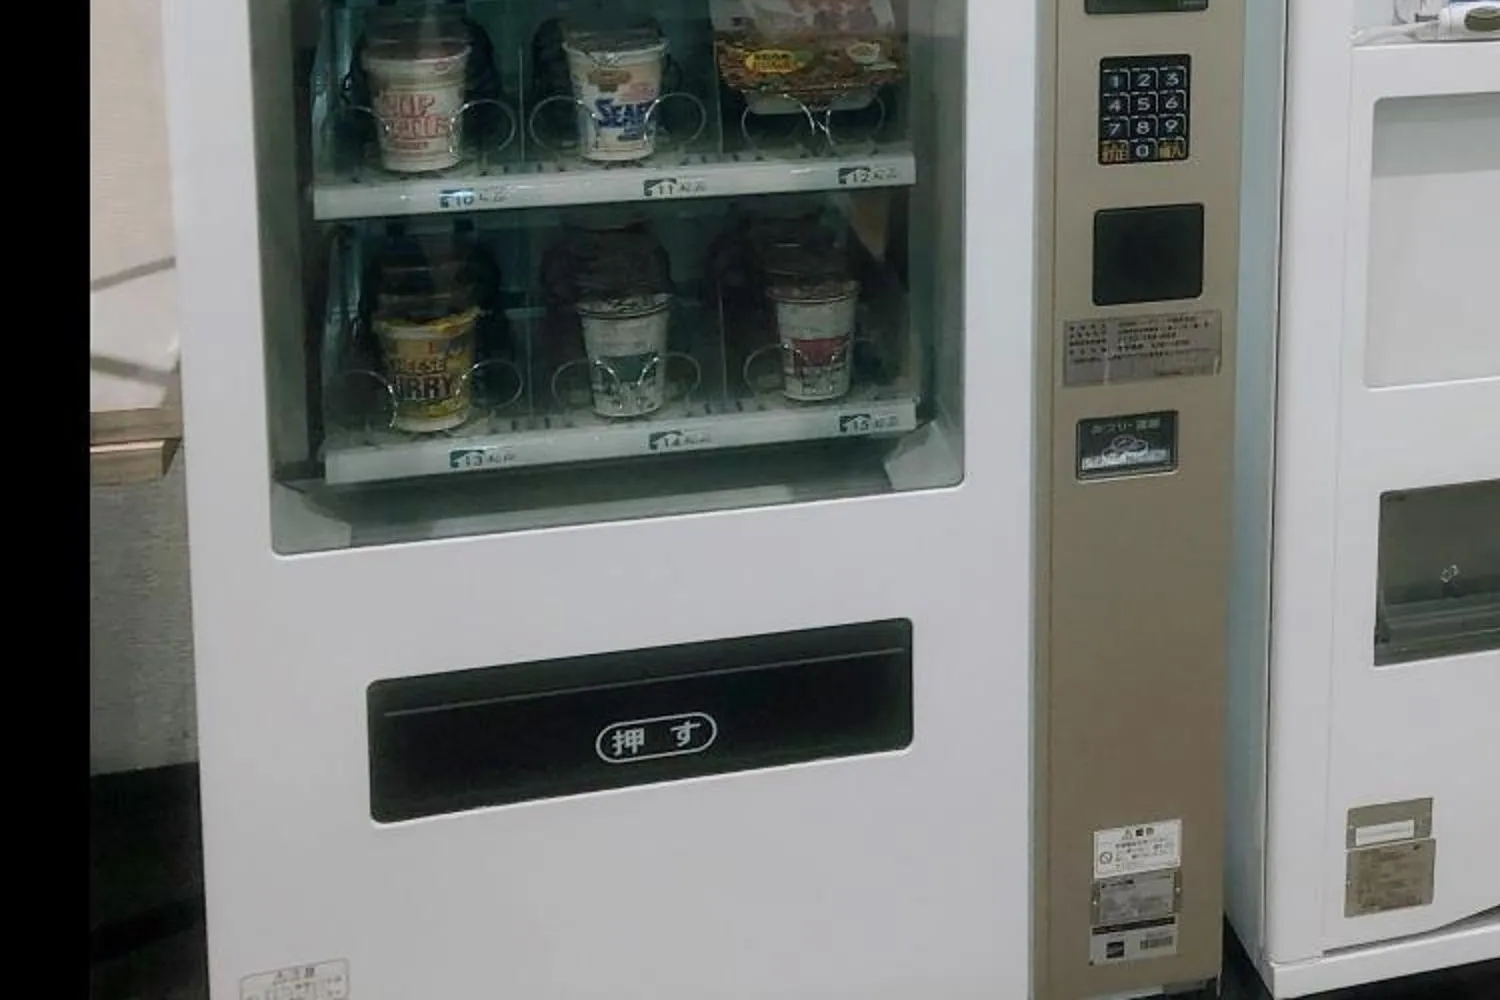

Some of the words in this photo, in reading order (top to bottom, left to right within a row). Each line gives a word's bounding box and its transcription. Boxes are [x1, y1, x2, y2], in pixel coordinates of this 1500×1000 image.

[1137, 73, 1151, 87] 2
[1166, 73, 1180, 87] 3
[1108, 99, 1122, 112] 4
[1137, 97, 1151, 111] 5
[1165, 96, 1179, 109] 6
[1109, 123, 1121, 136] 7
[1136, 121, 1150, 135] 8
[1165, 119, 1178, 133] 9
[1136, 144, 1149, 158] 0
